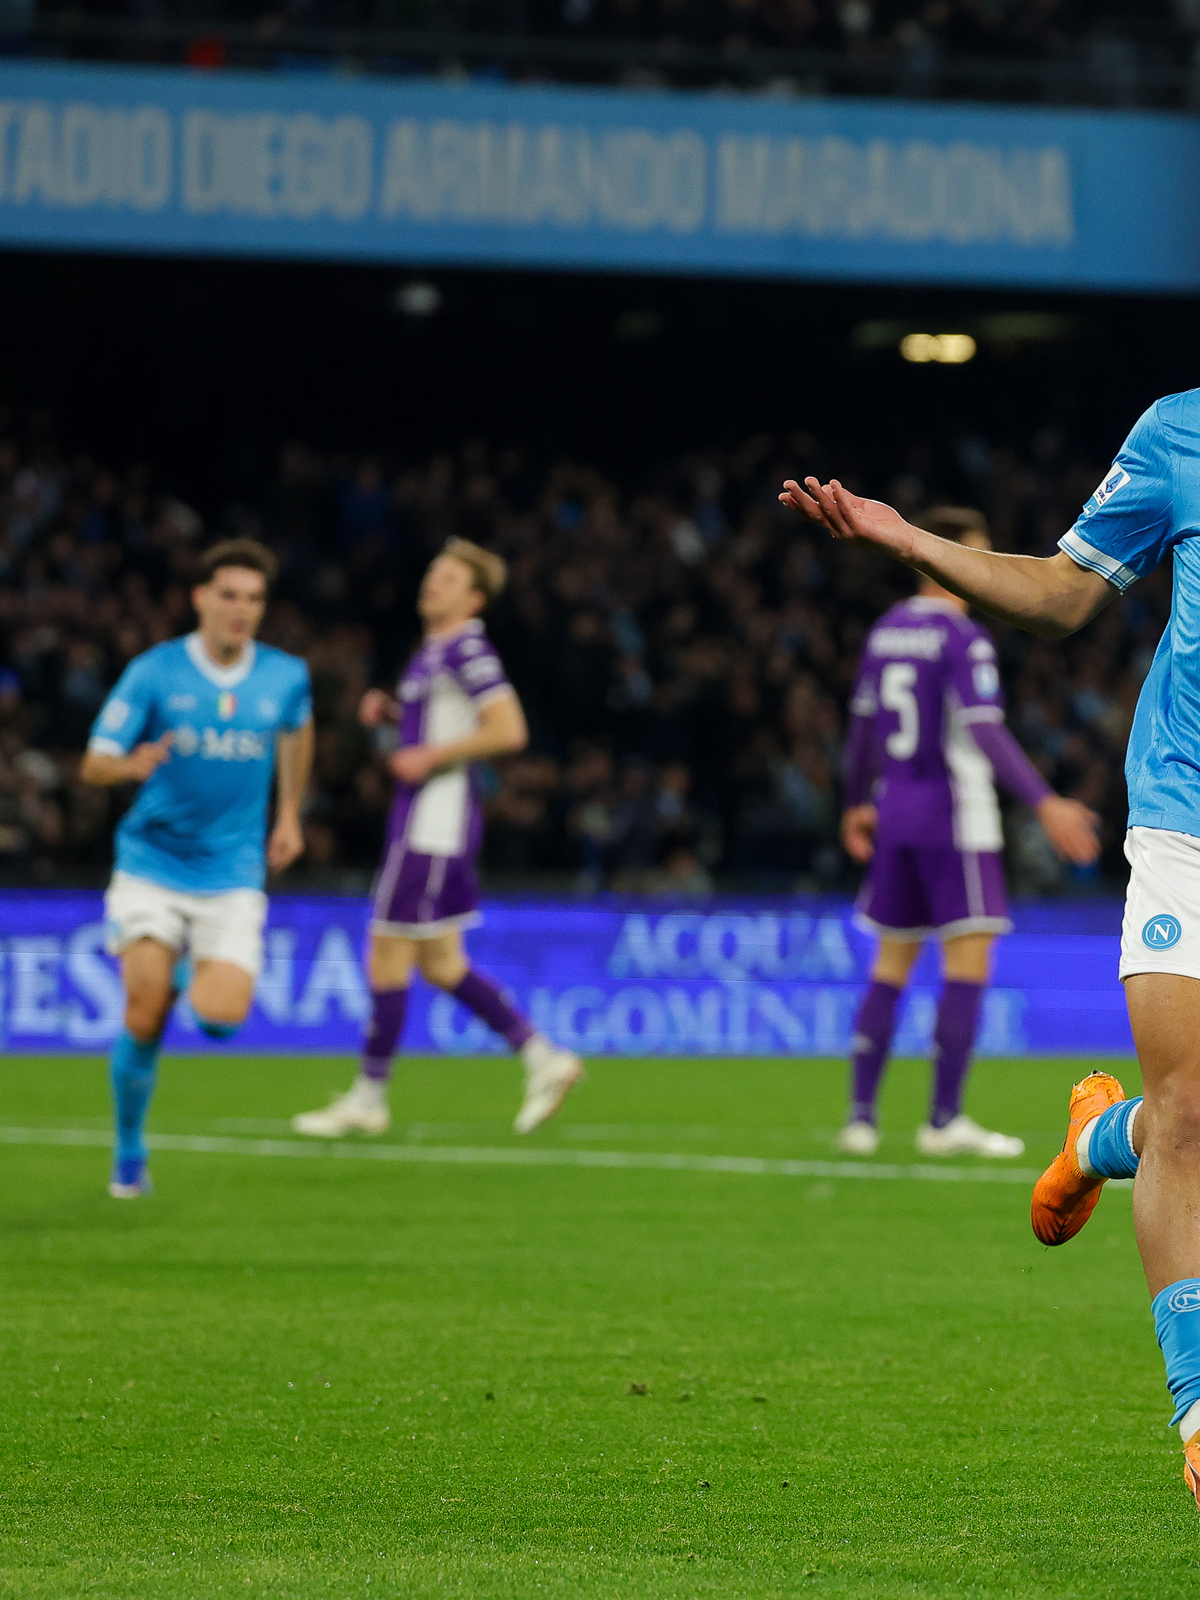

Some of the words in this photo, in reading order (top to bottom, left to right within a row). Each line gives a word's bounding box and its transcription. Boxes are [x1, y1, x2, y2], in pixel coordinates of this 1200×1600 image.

[181, 106, 374, 222] DIEGO
[880, 661, 920, 761] 5
[606, 911, 856, 980] ACQUA
[1152, 923, 1172, 942] N
